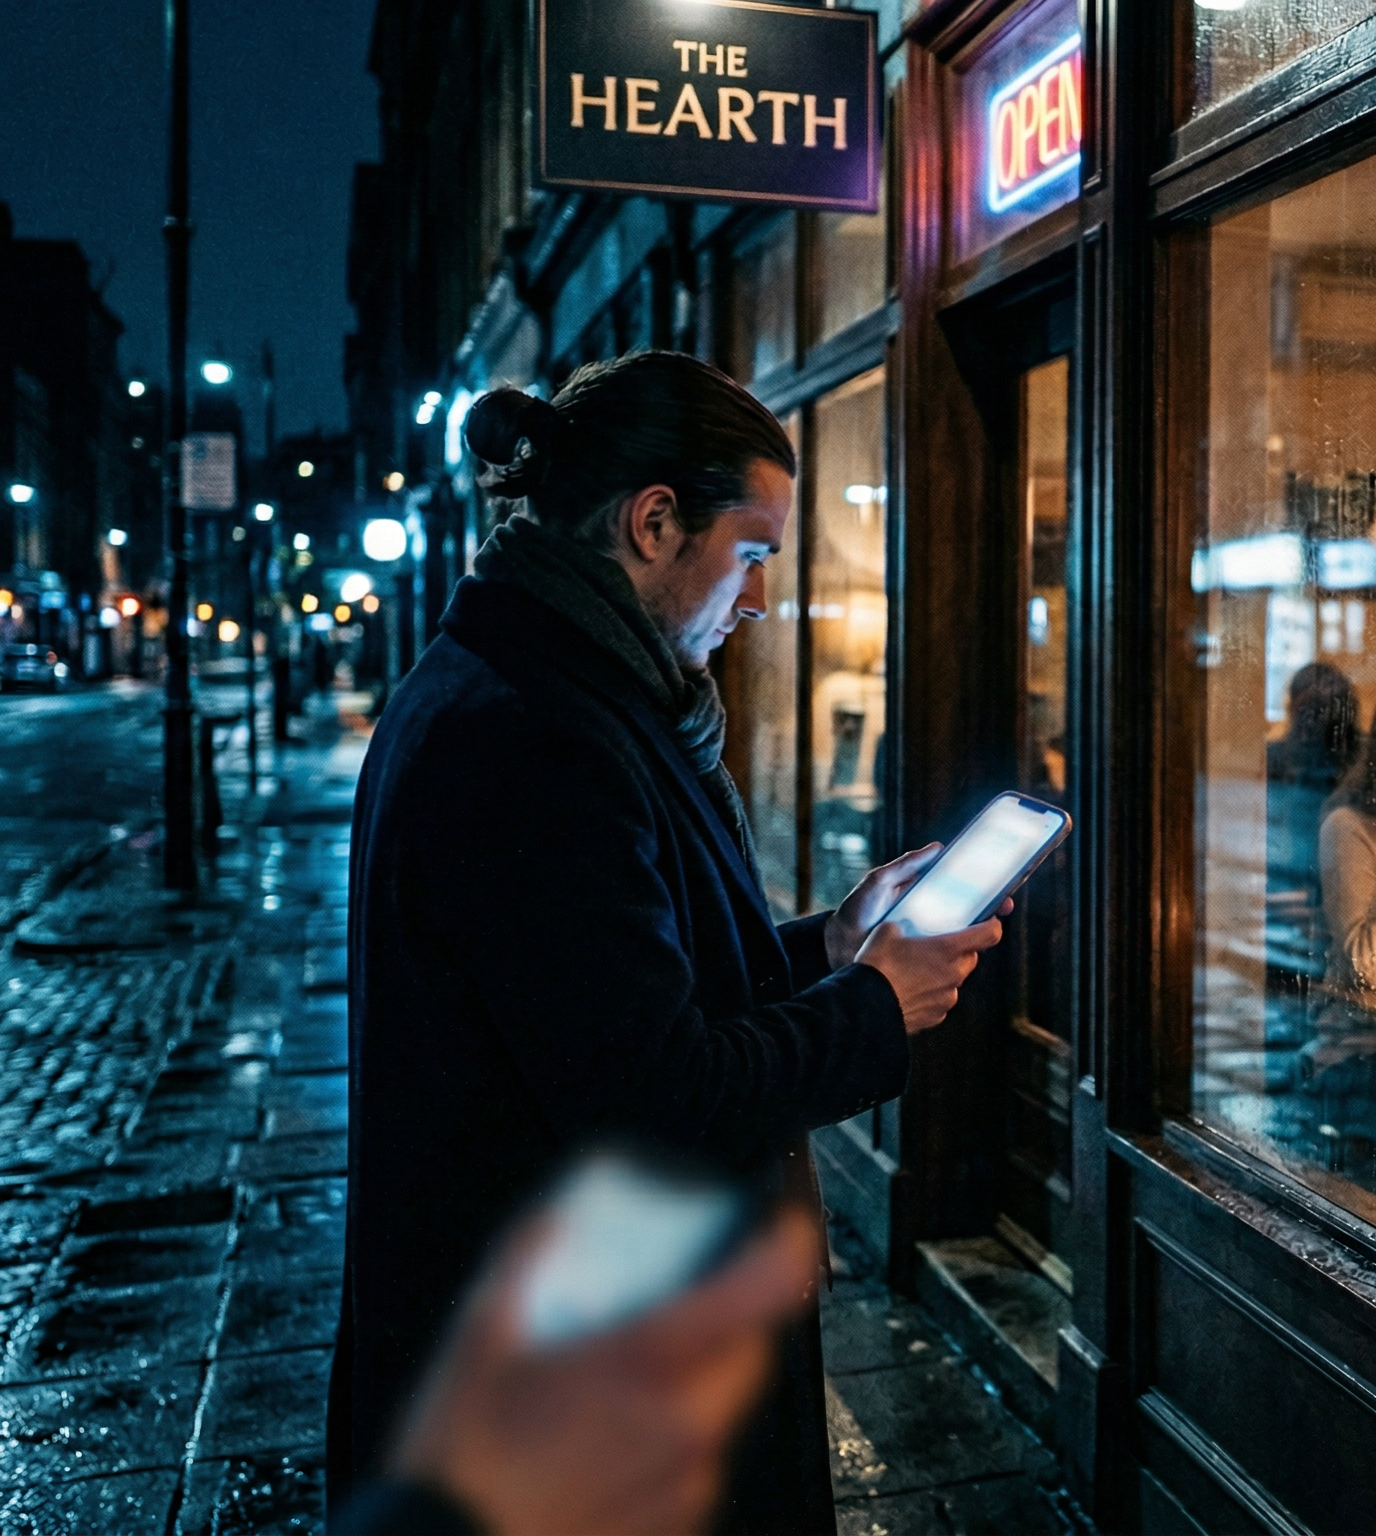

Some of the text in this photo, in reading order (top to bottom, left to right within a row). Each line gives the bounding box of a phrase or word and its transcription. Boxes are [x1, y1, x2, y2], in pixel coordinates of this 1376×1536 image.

[672, 40, 748, 77] THE
[570, 73, 847, 150] HEARTH
[999, 51, 1082, 188] OPEN
